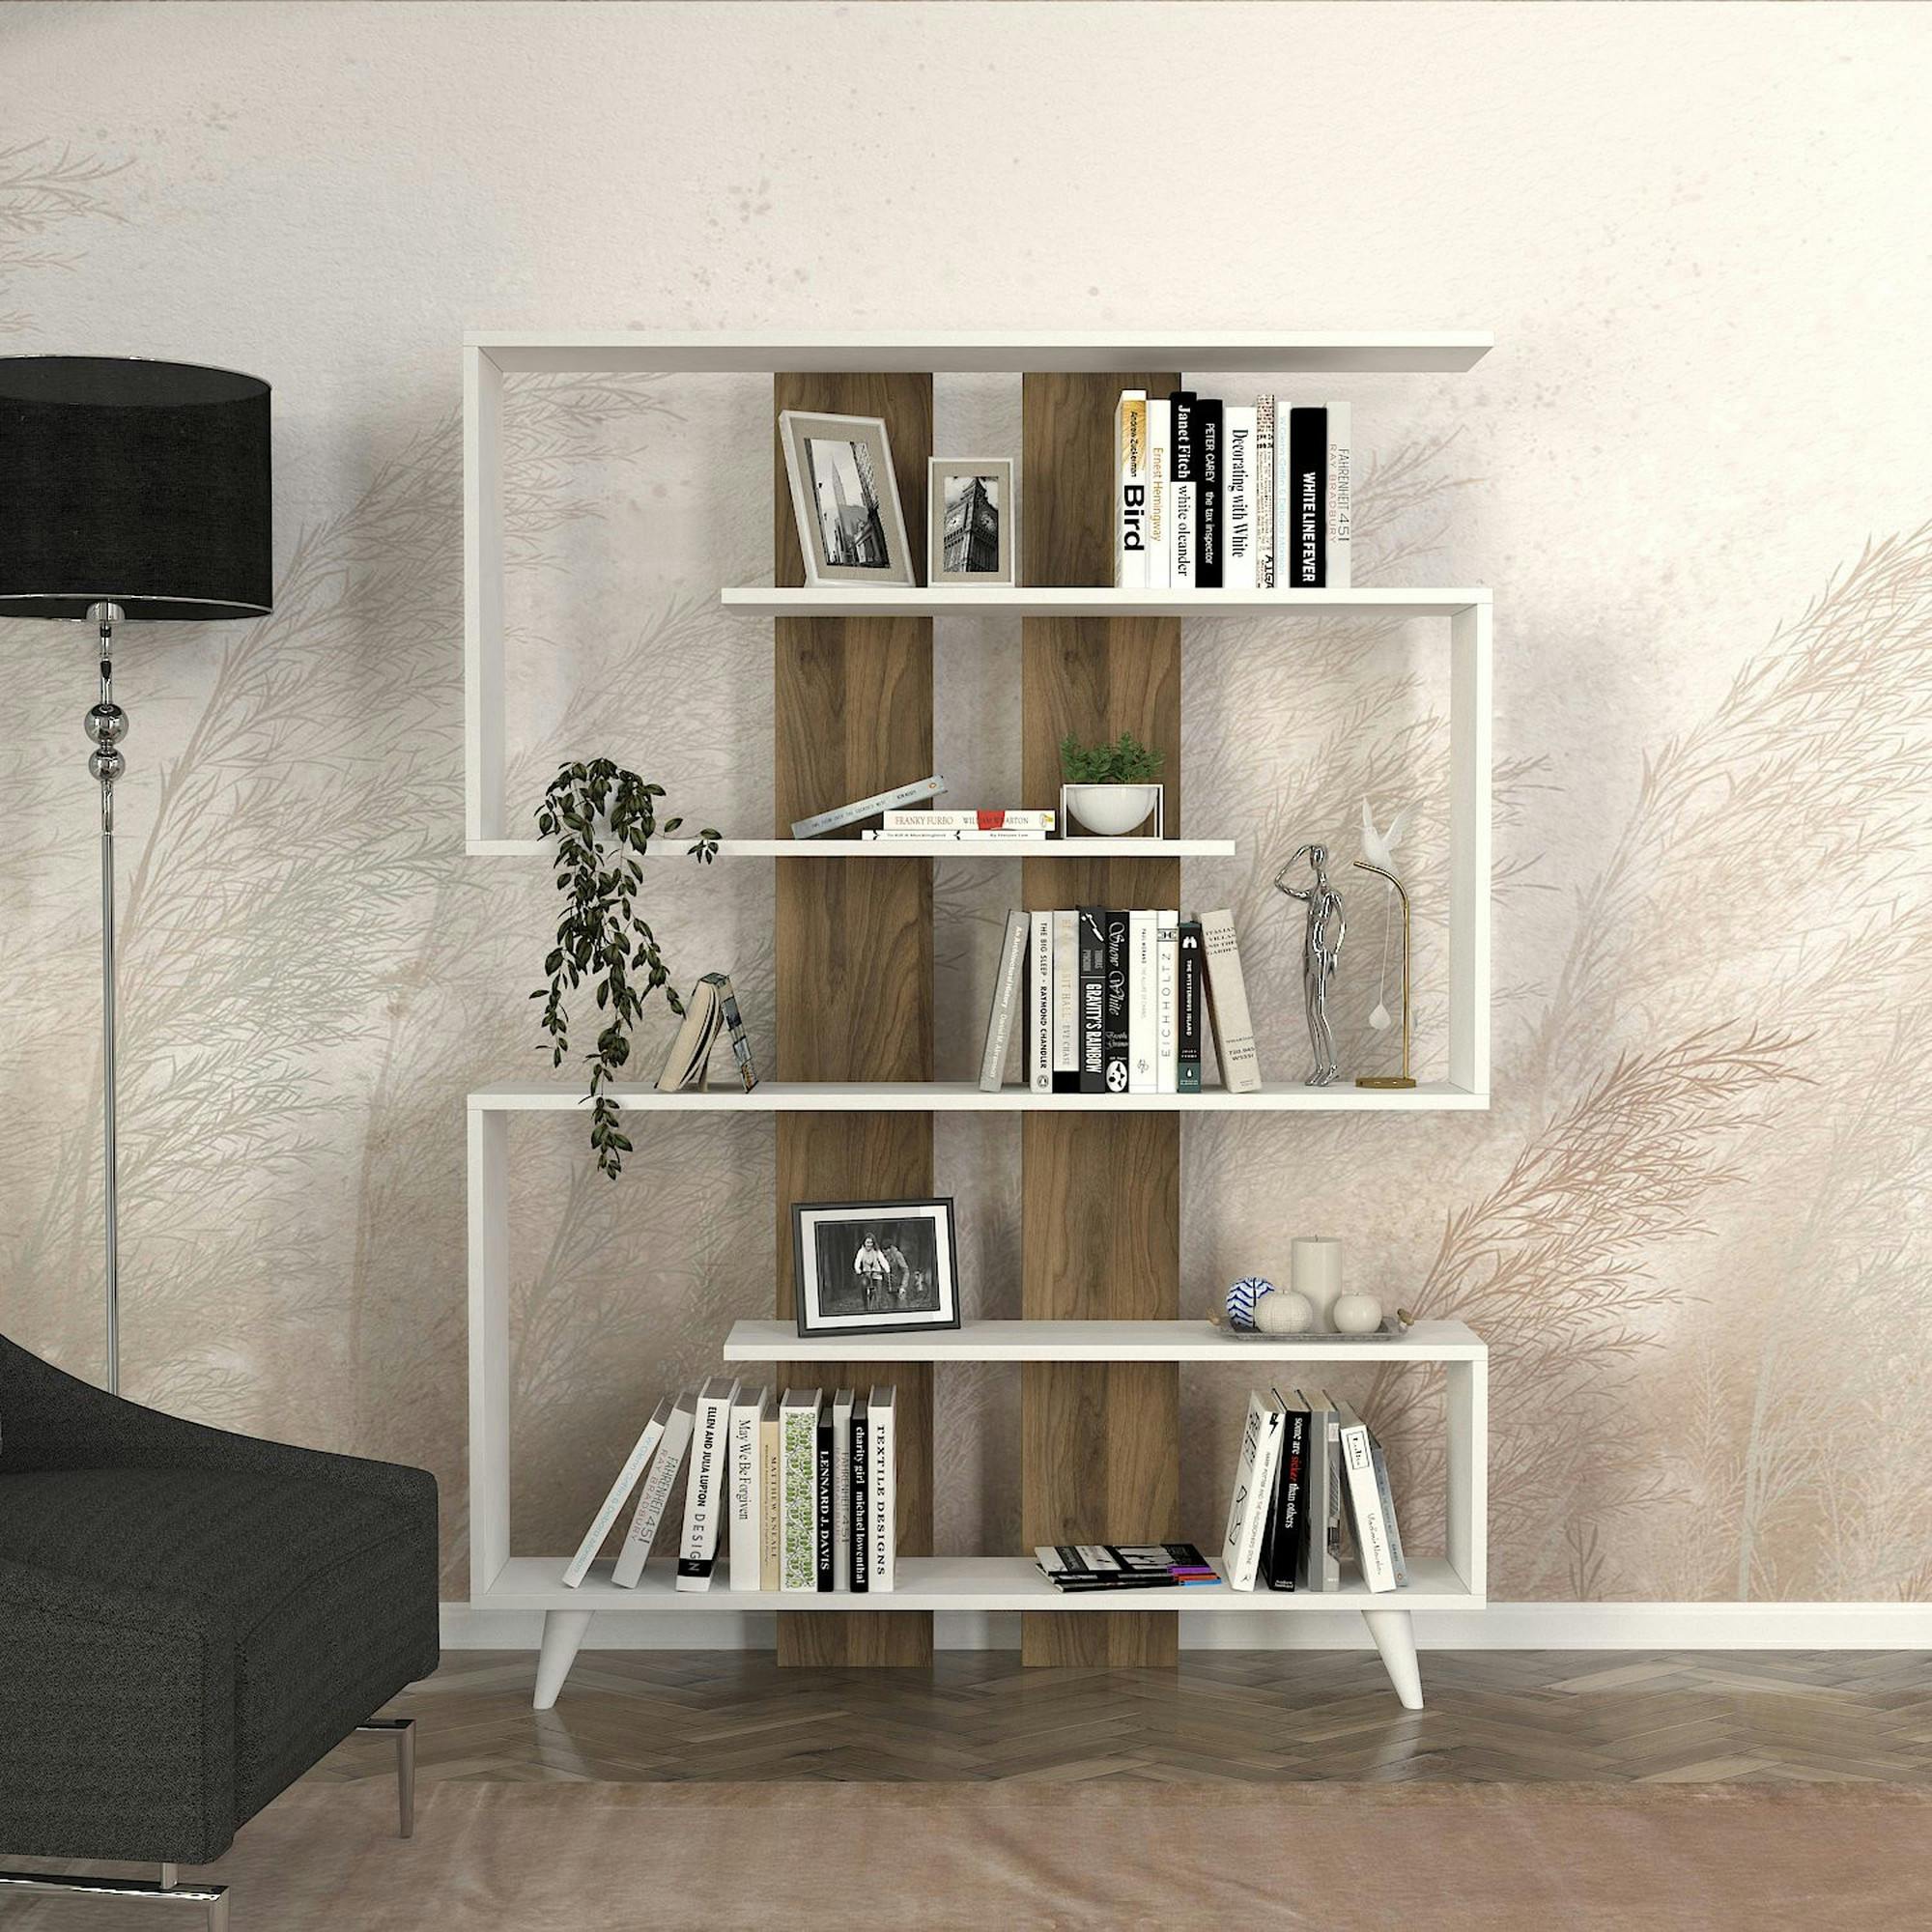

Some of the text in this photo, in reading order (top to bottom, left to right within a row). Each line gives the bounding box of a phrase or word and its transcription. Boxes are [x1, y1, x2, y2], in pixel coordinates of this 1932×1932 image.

[1178, 405, 1191, 478] Janet Fitch
[1205, 423, 1214, 482] PETER CAREY
[1123, 485, 1145, 551] Bird
[1151, 447, 1163, 542] Ernest Hemingway
[1178, 486, 1190, 577] white oleander
[1204, 492, 1214, 564] the tax inspector
[1228, 429, 1248, 558] Decorating with White
[1302, 472, 1316, 582] WHITE LINE FEVER
[1338, 448, 1350, 541] FAHRENHEIT 451
[1108, 922, 1125, 967] Snow
[1085, 983, 1102, 1073] GRAVITY'S RAINBOW
[1108, 970, 1125, 1016] White
[1160, 952, 1171, 1057] EICHHOLTZ
[629, 1447, 668, 1542] RAY BRADBURY
[638, 1455, 677, 1545] FAHRENHEIT 451
[696, 1406, 716, 1507] ELLEN AND JULIA LUPTON
[736, 1420, 752, 1520] May We Be Forgiven
[841, 1452, 850, 1512] FAHRENHEIT
[854, 1426, 865, 1484] charity girl
[1285, 1416, 1303, 1529] some are sicker than others
[688, 1513, 704, 1572] DESIGN
[820, 1451, 829, 1571] LENNARD J. DAVIS
[856, 1492, 865, 1583] michael lowenthal
